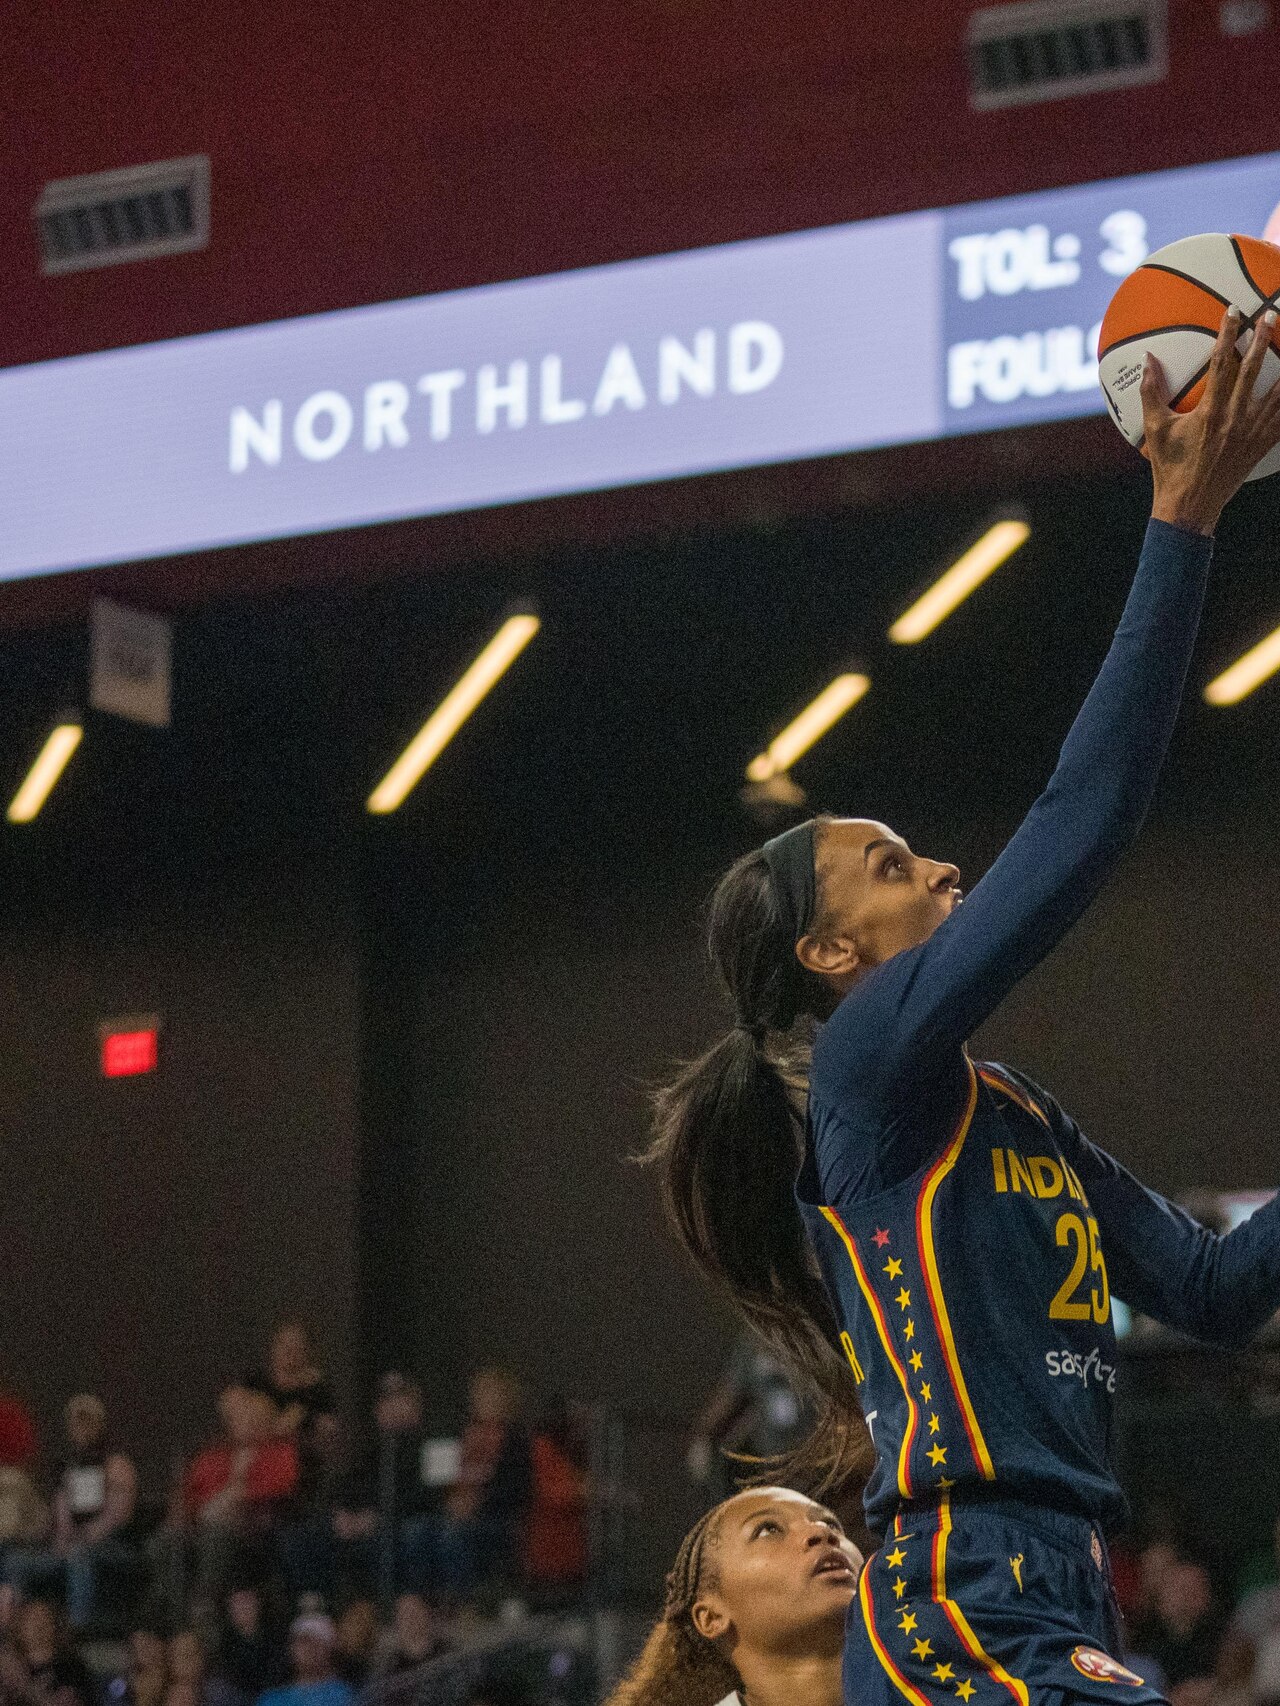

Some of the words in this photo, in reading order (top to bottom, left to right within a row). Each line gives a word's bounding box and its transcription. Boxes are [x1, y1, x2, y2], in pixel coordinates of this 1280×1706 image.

[948, 223, 1082, 302] TOL:
[1099, 209, 1150, 278] 3
[227, 319, 784, 475] NORTHLAND
[1049, 1212, 1110, 1325] 25
